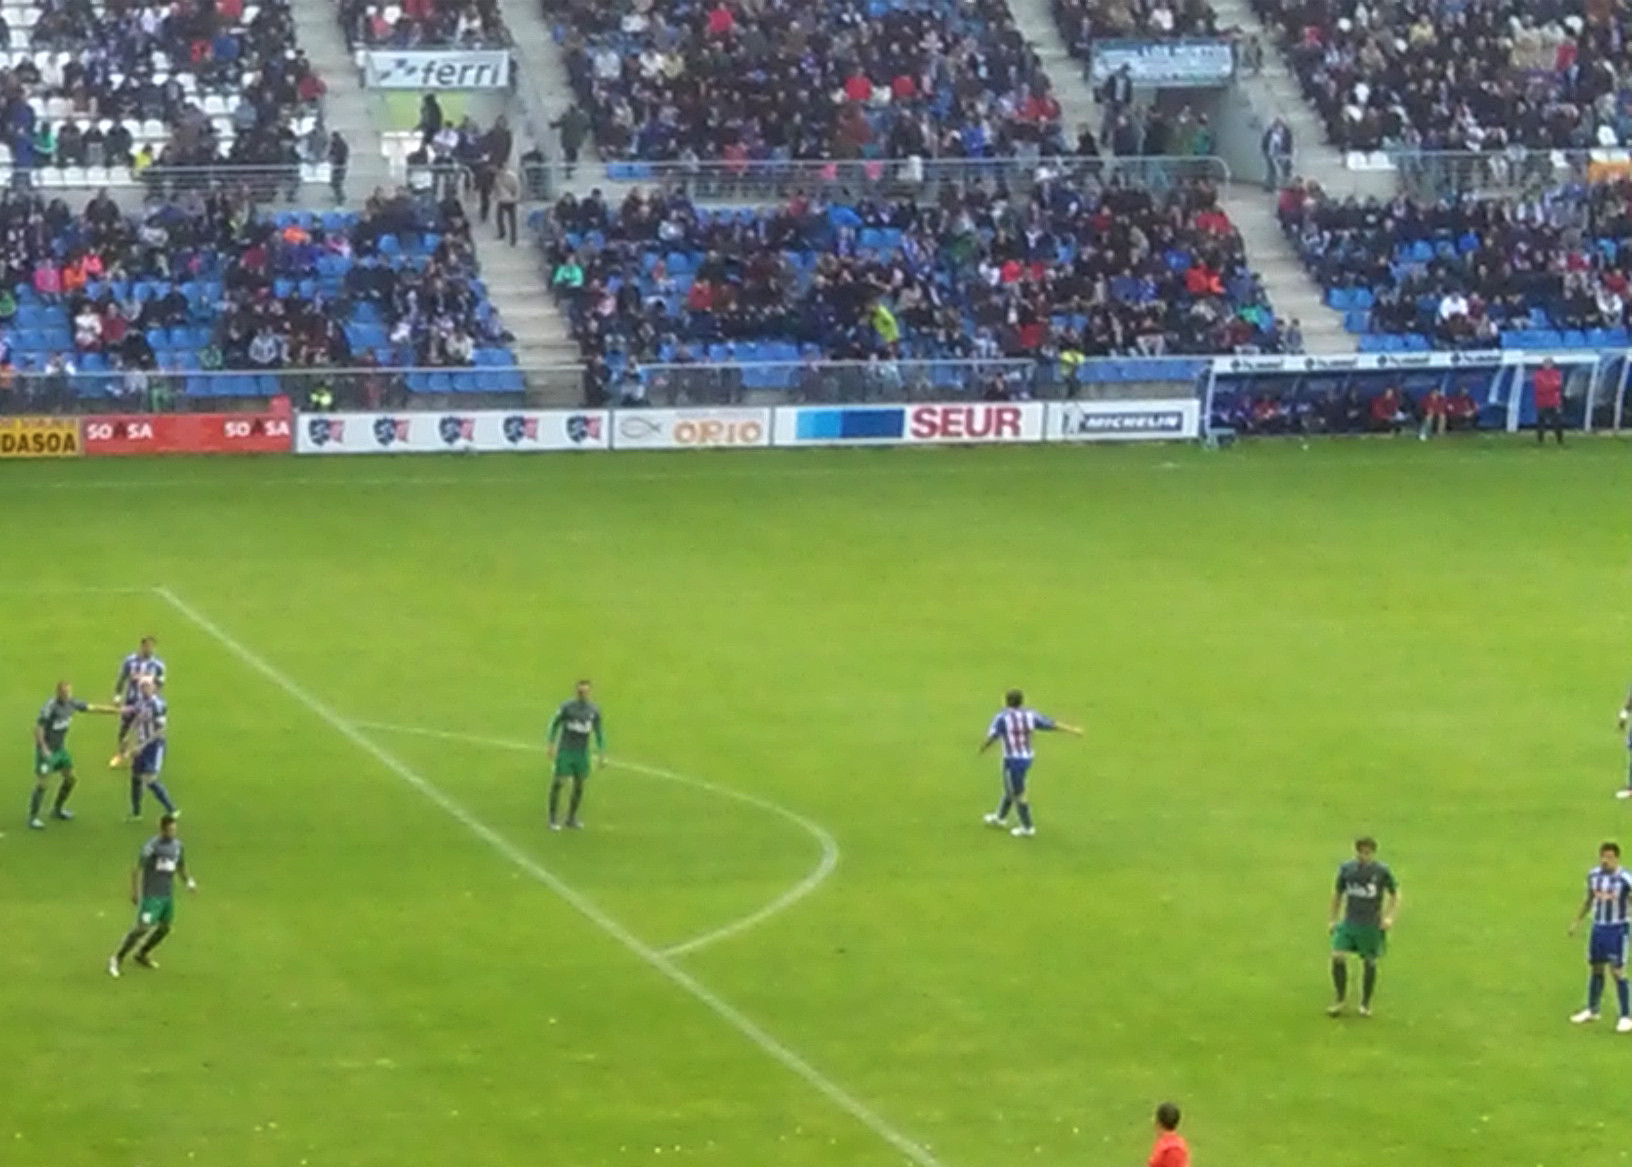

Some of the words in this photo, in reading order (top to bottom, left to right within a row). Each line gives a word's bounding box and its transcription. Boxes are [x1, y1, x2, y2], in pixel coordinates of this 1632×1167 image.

[422, 60, 499, 85] ferri
[674, 420, 763, 444] ORIO
[911, 407, 1022, 438] SEUR
[1085, 416, 1180, 428] MICHELIN
